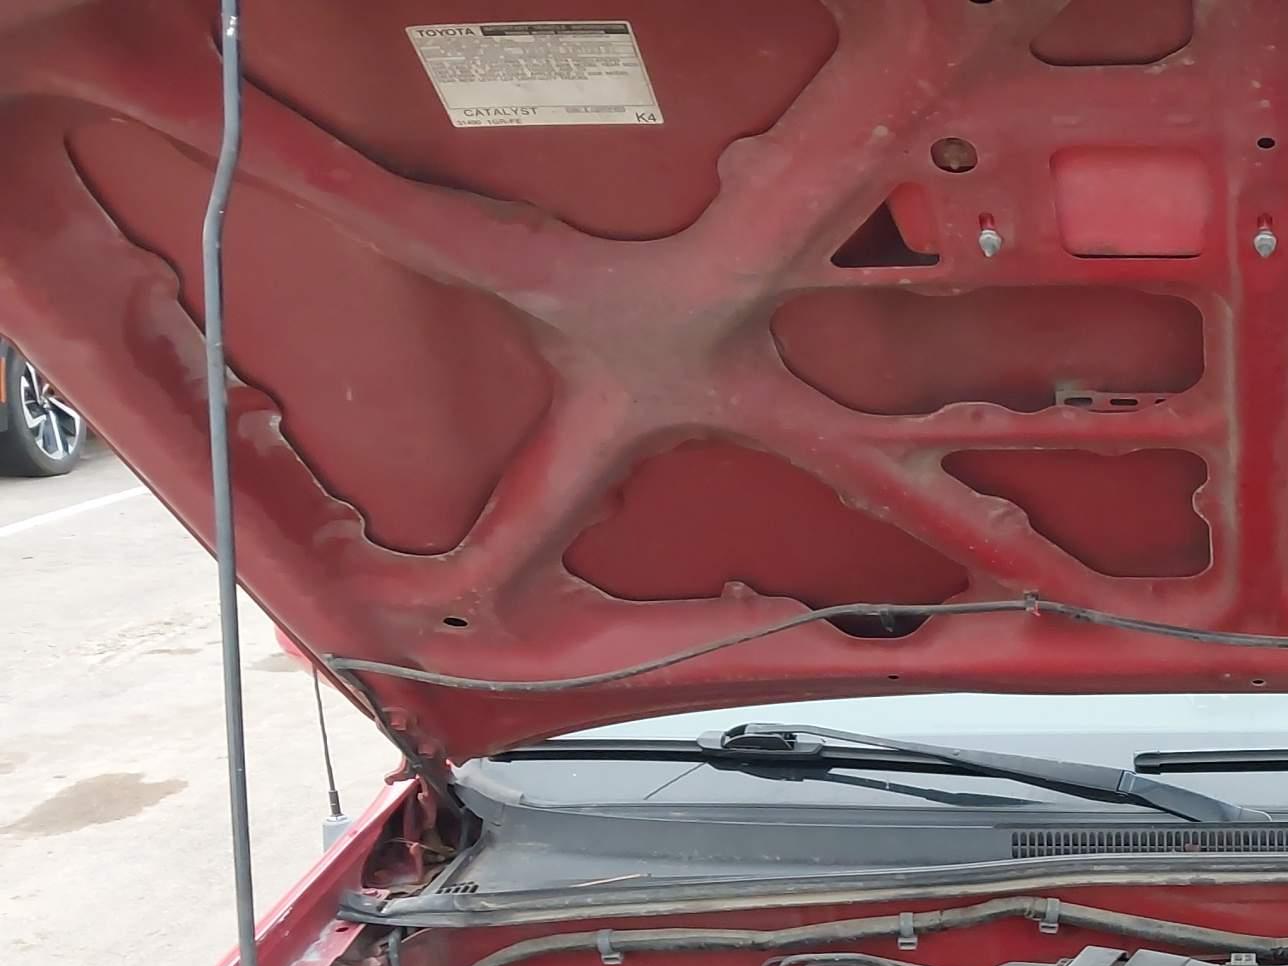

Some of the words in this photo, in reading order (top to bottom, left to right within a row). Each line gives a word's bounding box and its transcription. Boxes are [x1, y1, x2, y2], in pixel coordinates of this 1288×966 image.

[416, 27, 476, 38] TOYOTA
[463, 107, 537, 117] CATALYST
[635, 112, 657, 123] K4
